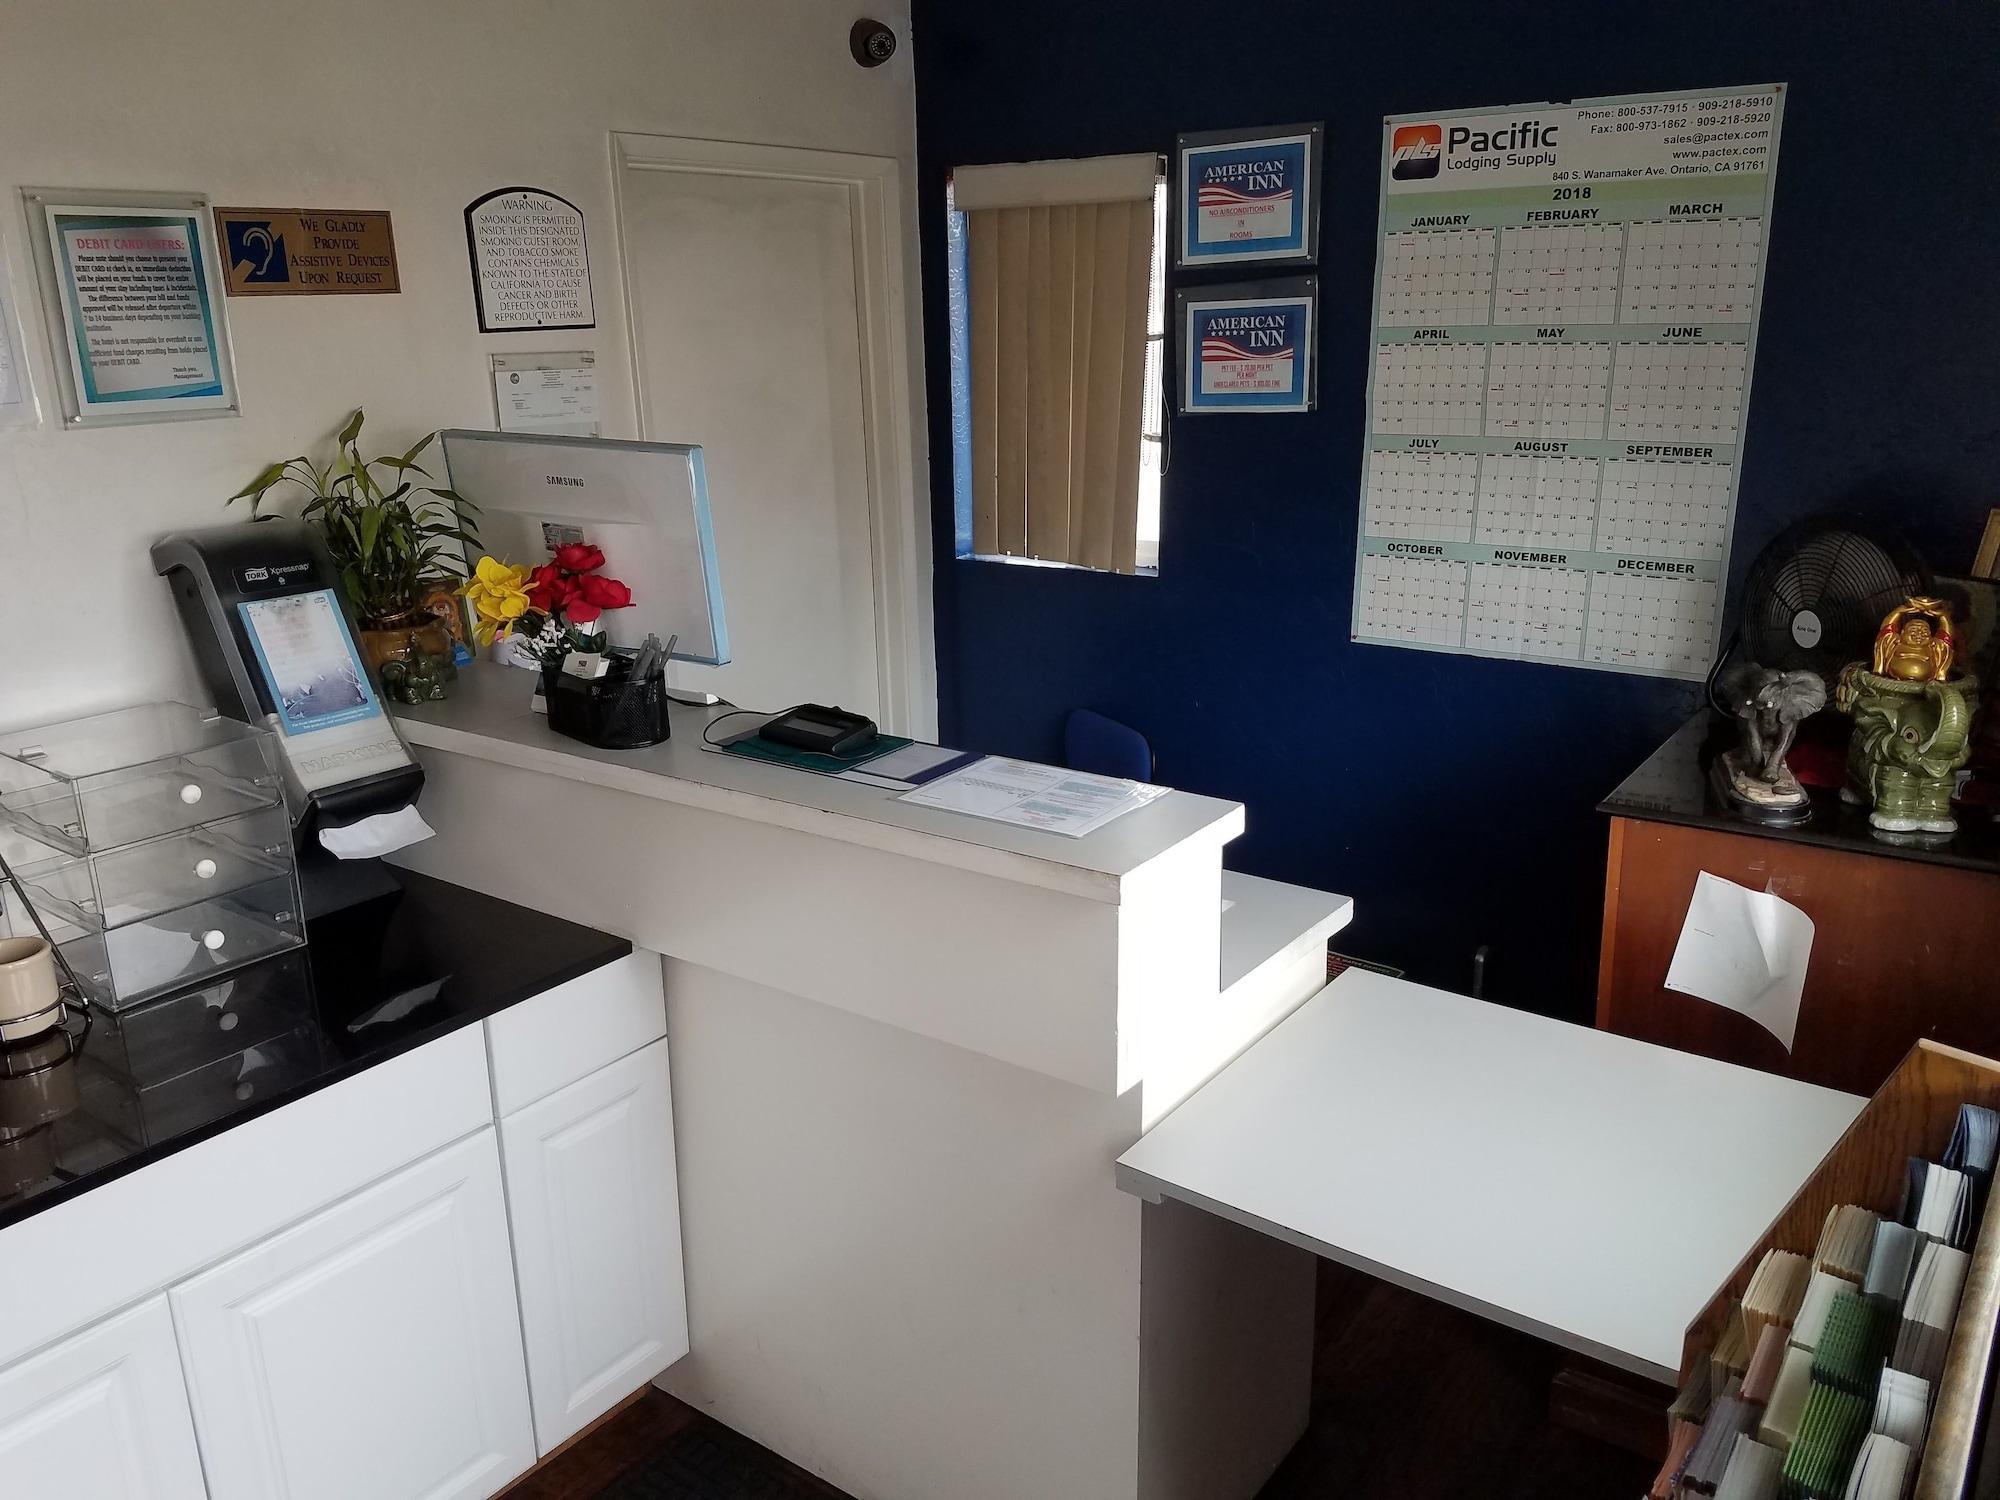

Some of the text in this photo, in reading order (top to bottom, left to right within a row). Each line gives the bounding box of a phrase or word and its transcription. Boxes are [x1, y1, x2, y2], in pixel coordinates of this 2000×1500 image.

[1578, 96, 1773, 121] Phone: 800-537-7915 909-218-5910
[1590, 112, 1771, 134] Fax: 800-973-1862 909-218-5920
[1448, 121, 1559, 154] Pacific
[1664, 129, 1769, 146] sales@pactex.com
[1672, 145, 1767, 161] www.pactex.com
[1447, 152, 1557, 171] Lodging Supply
[1204, 160, 1285, 178] AMERICAN
[1552, 160, 1765, 181] 840 S. Wanamaker Ave. Ontario, CA 91761
[1248, 173, 1284, 191] INN
[1552, 187, 1591, 201] 2018
[501, 200, 553, 211] WARNING
[1668, 203, 1723, 216] MARCH
[480, 215, 576, 225] SMOKING IS PERMITTED
[1411, 215, 1471, 227] JANUARY
[1526, 208, 1600, 222] FEBRUARY
[300, 218, 367, 233] WE GLADLY
[479, 226, 580, 235] INSIDE THIS DESIGNATED
[480, 237, 522, 246] SMOKING
[524, 237, 549, 246] GUEST
[1230, 231, 1253, 239] ROOMS
[76, 239, 109, 250] DEBIT
[114, 239, 144, 250] CARD
[314, 237, 359, 249] PROVIDE
[486, 248, 579, 257] AND TOBACCO SMOKE
[290, 254, 390, 267] ASSISTIVE DEVICES
[487, 259, 579, 268] CONTAINS CHEMICALS
[299, 271, 383, 285] UPON REQUEST
[482, 268, 587, 279] KNOWN TO THE STATE OF
[490, 279, 582, 289] CALIFORNIA TO CAUSE
[497, 289, 578, 300] CANCER AND BIRTH
[500, 300, 579, 311] DEFECTS OR OTHER
[495, 311, 557, 322] REPRODUCTIVE
[1207, 315, 1286, 331] AMERICAN
[1250, 330, 1286, 347] INN
[1413, 328, 1450, 340] APRIL
[1536, 327, 1566, 339] MAY
[1662, 327, 1703, 338] JUNE
[1408, 438, 1439, 449] JULY
[1514, 441, 1569, 453] AUGUST
[1626, 445, 1713, 458] SEPTEMBER
[546, 475, 585, 488] SAMSUNG
[1387, 543, 1443, 556] OCTOBER
[1494, 550, 1567, 564] NOVEMBER
[1617, 559, 1695, 574] DECEMBER
[246, 571, 267, 580] TORK
